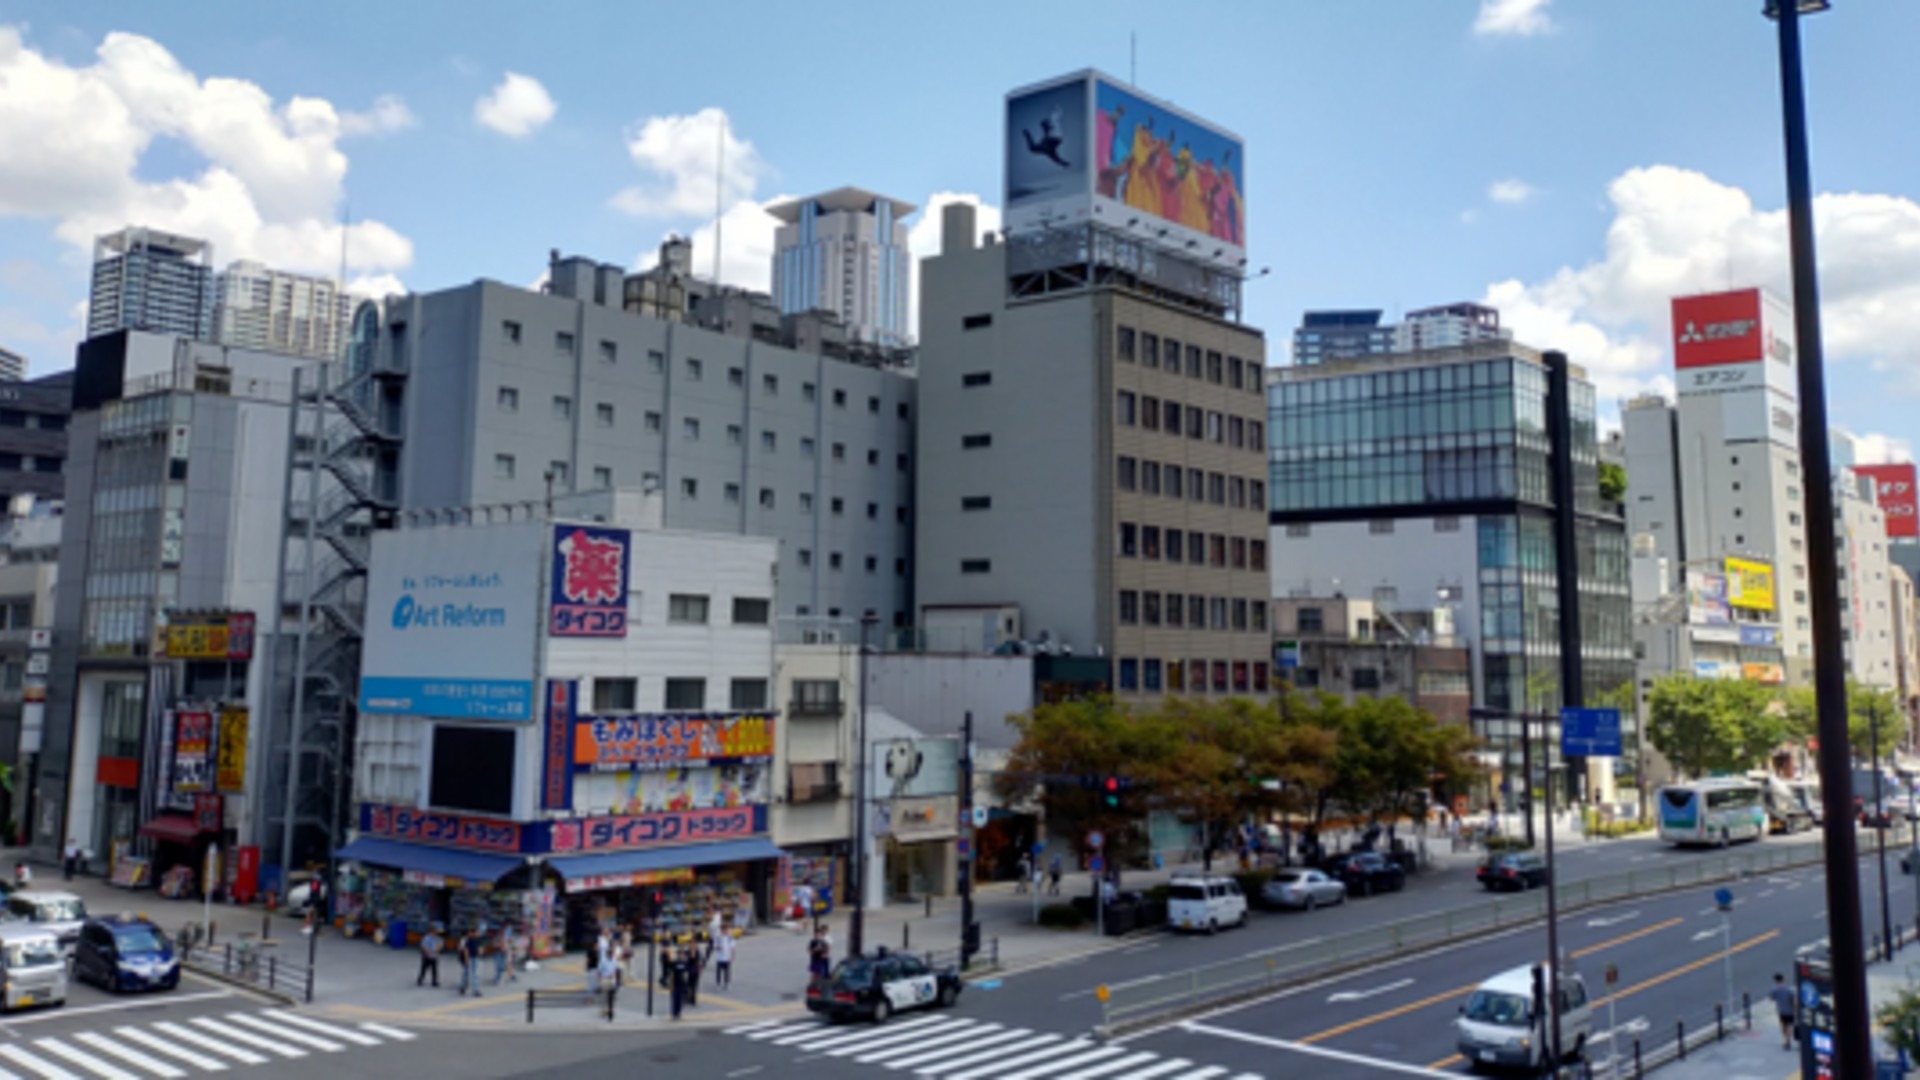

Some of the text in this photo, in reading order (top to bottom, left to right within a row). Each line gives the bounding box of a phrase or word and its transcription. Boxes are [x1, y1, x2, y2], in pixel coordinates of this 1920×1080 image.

[1693, 370, 1747, 386] エアコン
[414, 602, 506, 628] Art Reform
[554, 609, 625, 632] ダイコク
[593, 715, 698, 742] もみほぐし
[398, 811, 460, 841] ダイコク
[464, 822, 514, 846] ドラッグ
[590, 816, 682, 847] ダイコク
[687, 812, 748, 837] ドラッグ
